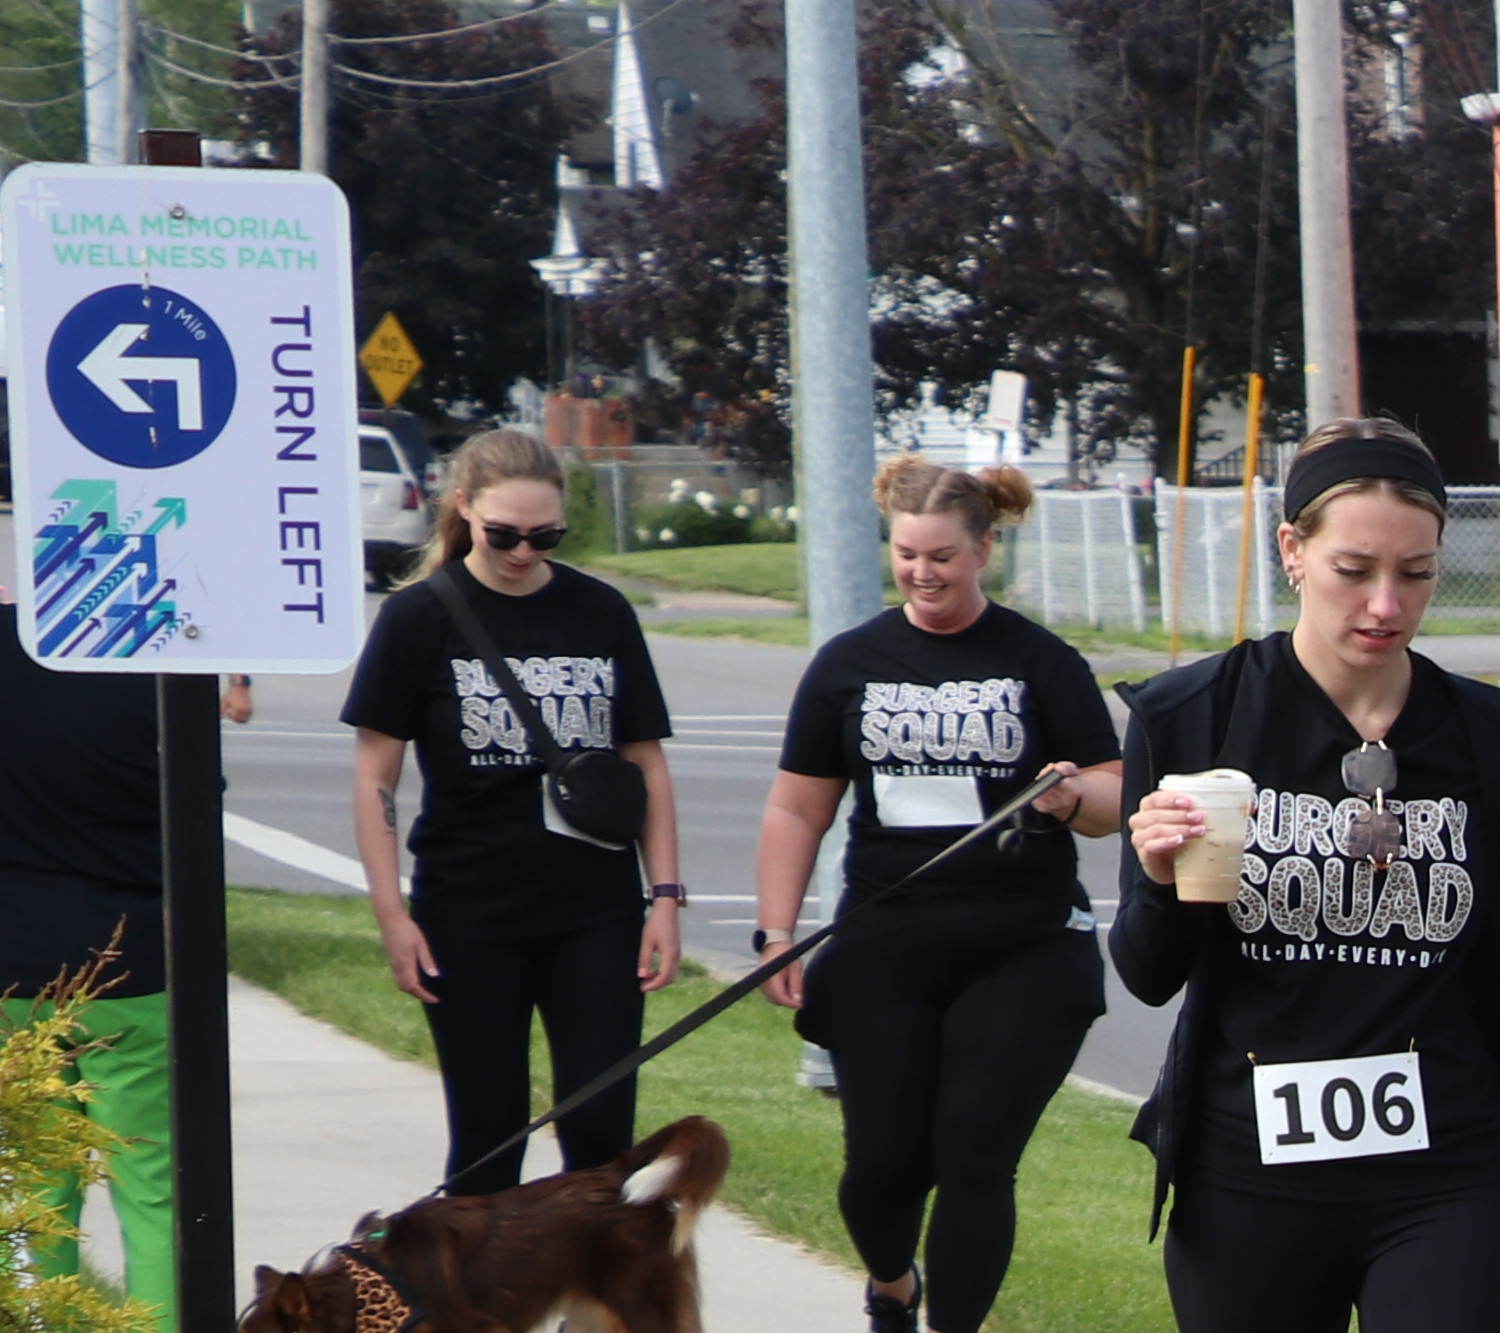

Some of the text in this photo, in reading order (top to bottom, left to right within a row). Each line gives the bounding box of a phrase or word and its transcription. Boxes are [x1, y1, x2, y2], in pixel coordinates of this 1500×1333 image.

[53, 213, 312, 241] LIMA MEMORIAL
[54, 244, 318, 270] WELLNESS PATH
[165, 300, 208, 342] 1 Mile
[380, 336, 399, 351] NO
[270, 305, 324, 624] TURN LEFT
[451, 657, 615, 697] SUGERY
[861, 678, 1025, 714] SURGERY
[860, 711, 1025, 764] SQUAD
[1227, 853, 1474, 942] SQUAD
[1273, 1072, 1415, 1146] 106
